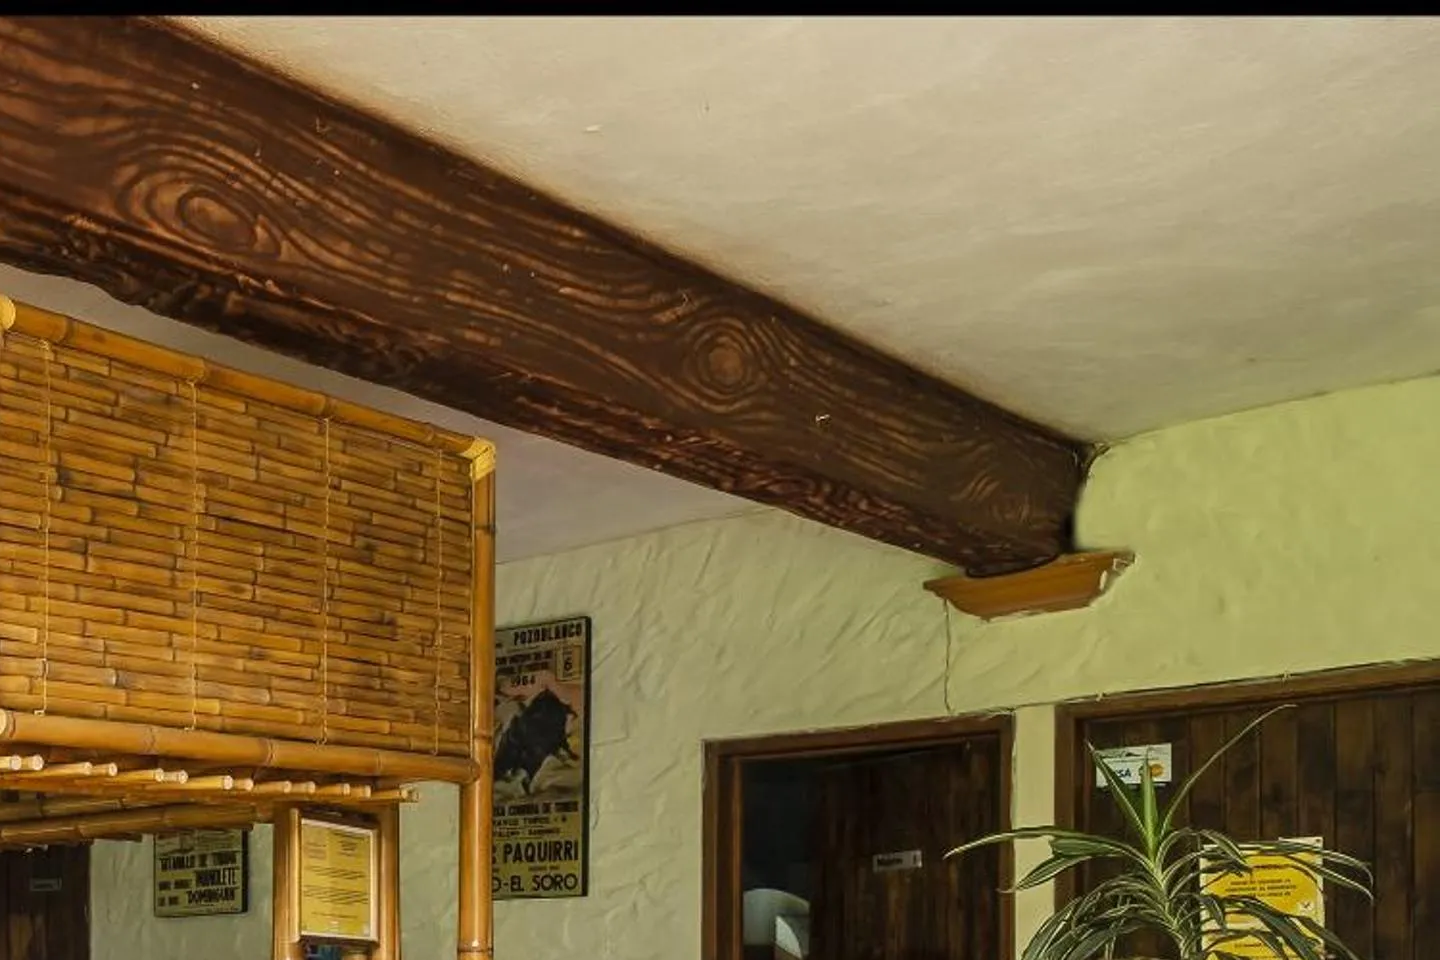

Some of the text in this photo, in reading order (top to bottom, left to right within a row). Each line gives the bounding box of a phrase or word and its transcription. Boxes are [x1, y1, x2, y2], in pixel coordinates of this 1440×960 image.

[513, 622, 582, 646] POZOBLANCO
[503, 840, 579, 864] PAQUIRRI
[531, 873, 578, 892] SORO
